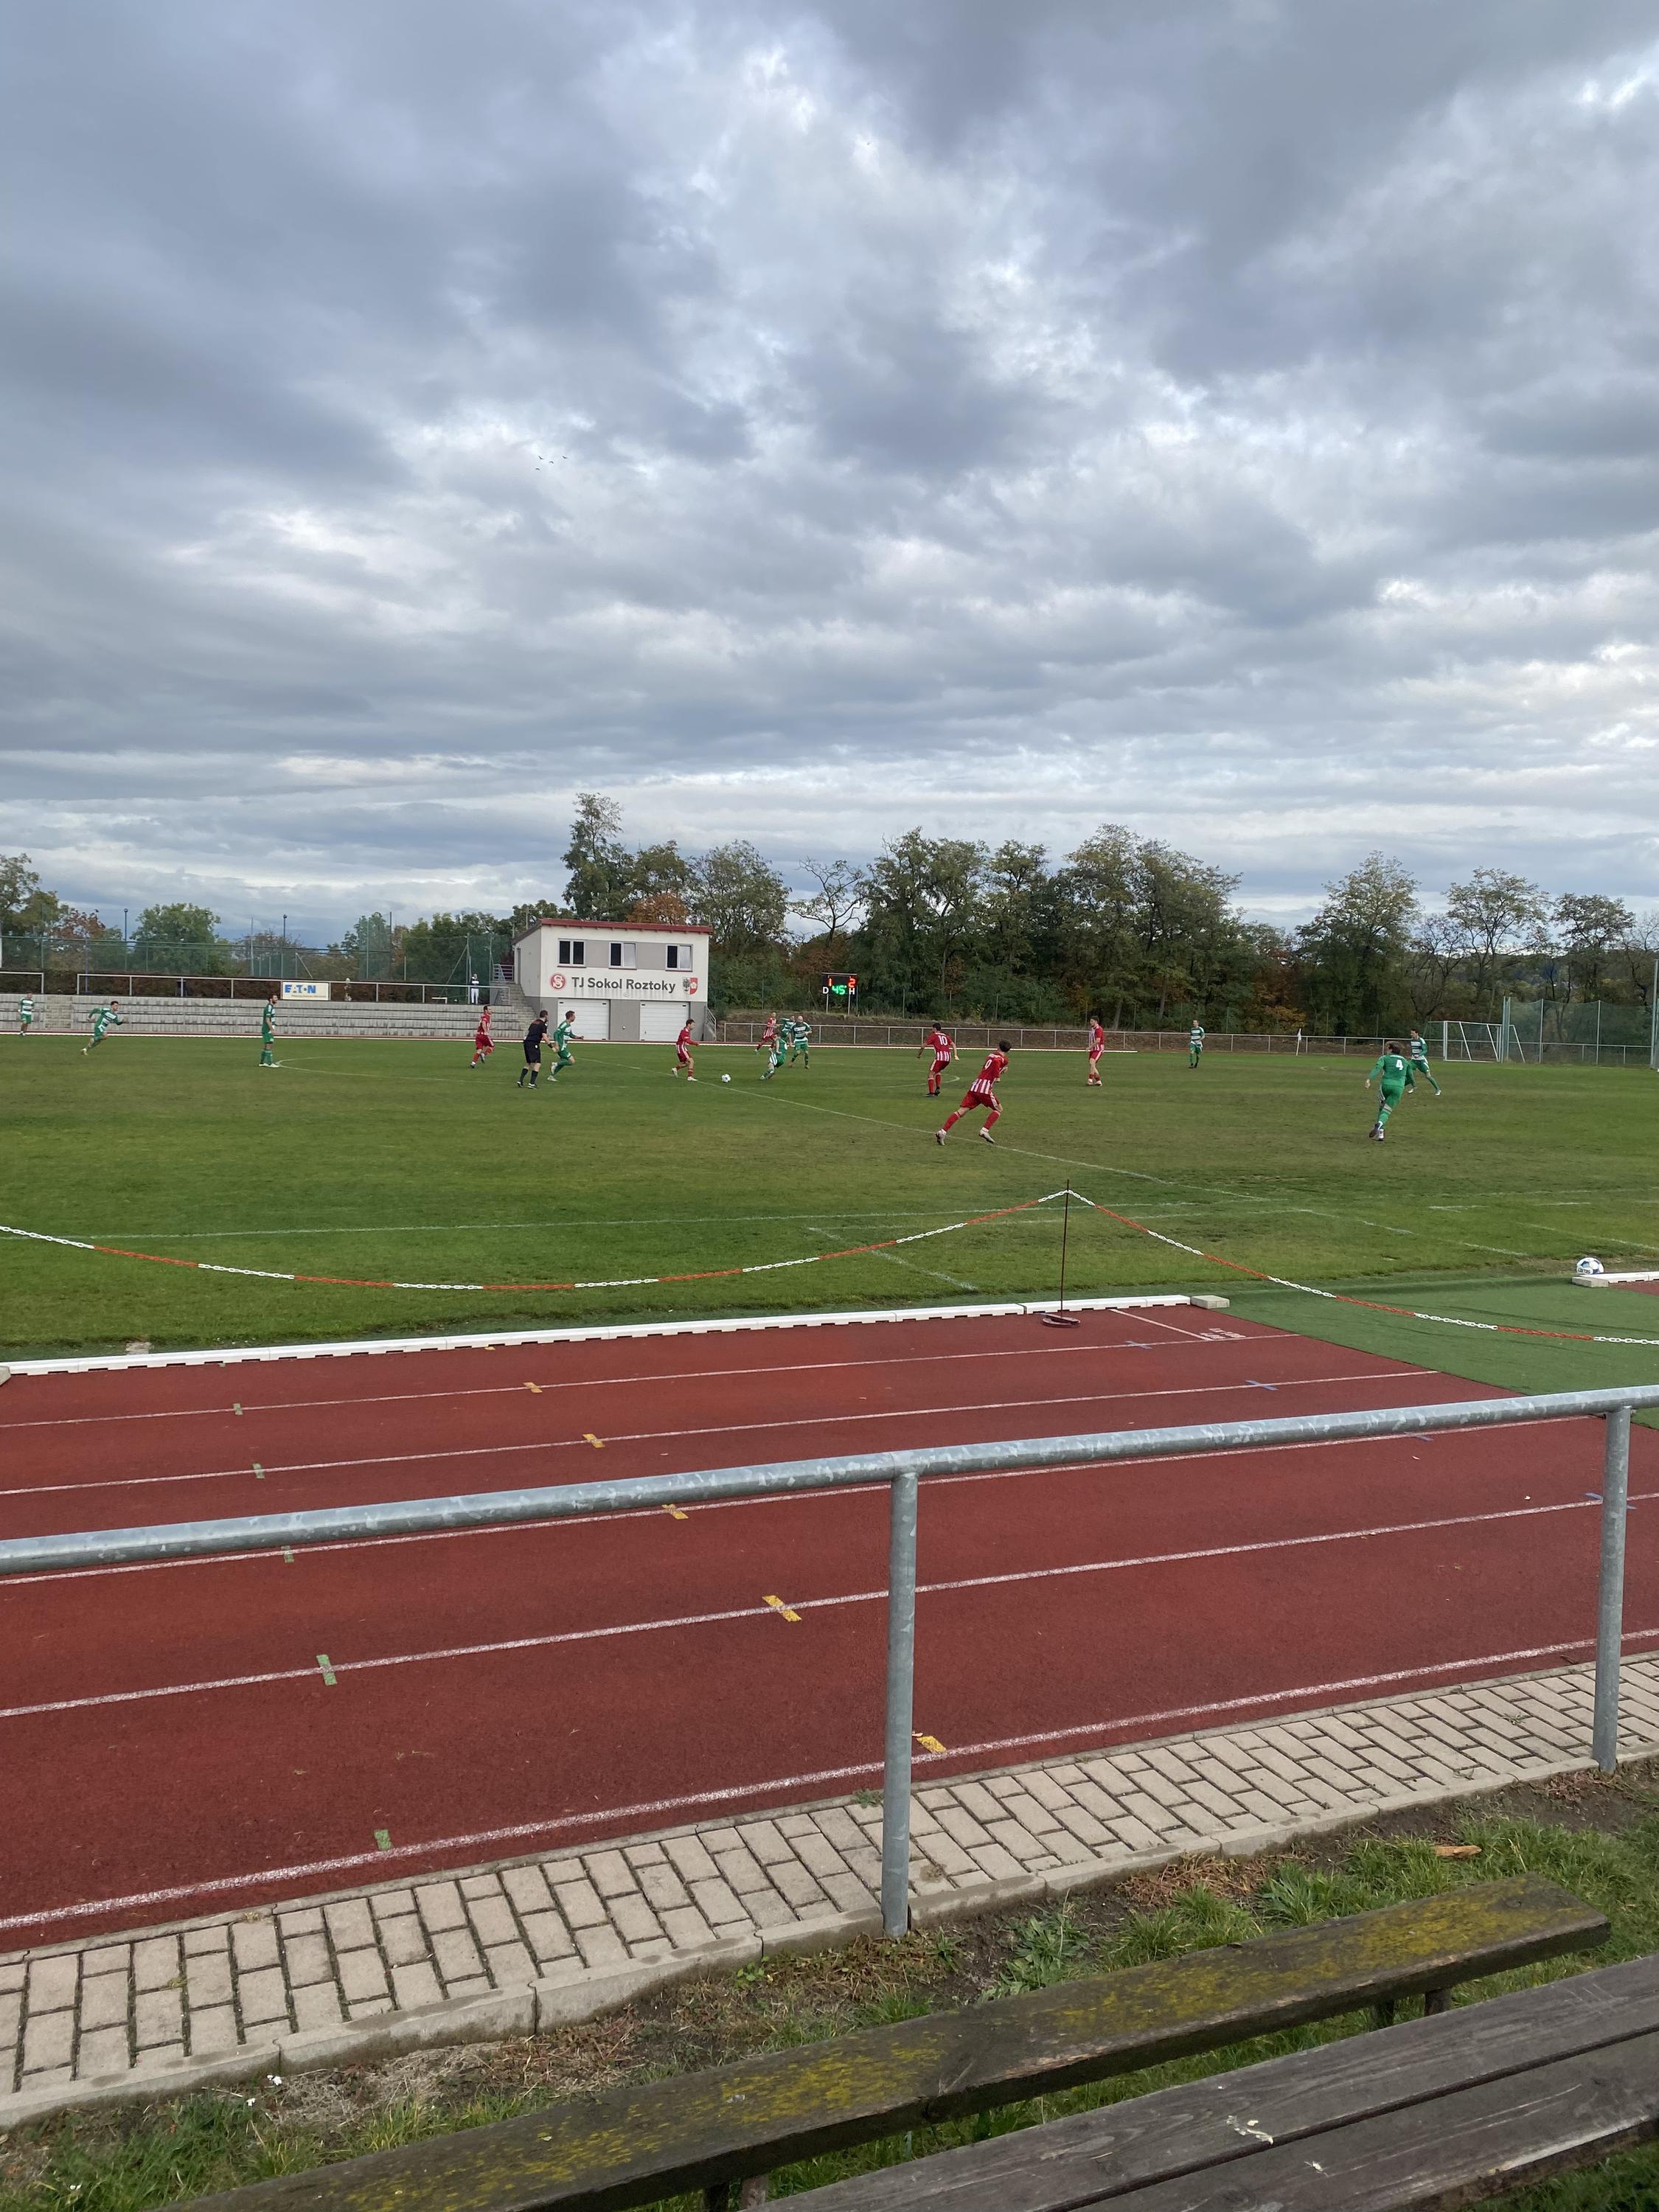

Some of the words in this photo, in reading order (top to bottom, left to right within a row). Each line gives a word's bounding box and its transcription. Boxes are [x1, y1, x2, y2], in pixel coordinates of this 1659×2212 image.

[571, 977, 584, 987] TJ
[588, 978, 622, 989] Sokol
[626, 978, 676, 994] Roztoky
[848, 978, 855, 987] 2
[938, 1035, 947, 1046] 10
[1396, 1060, 1404, 1071] 4
